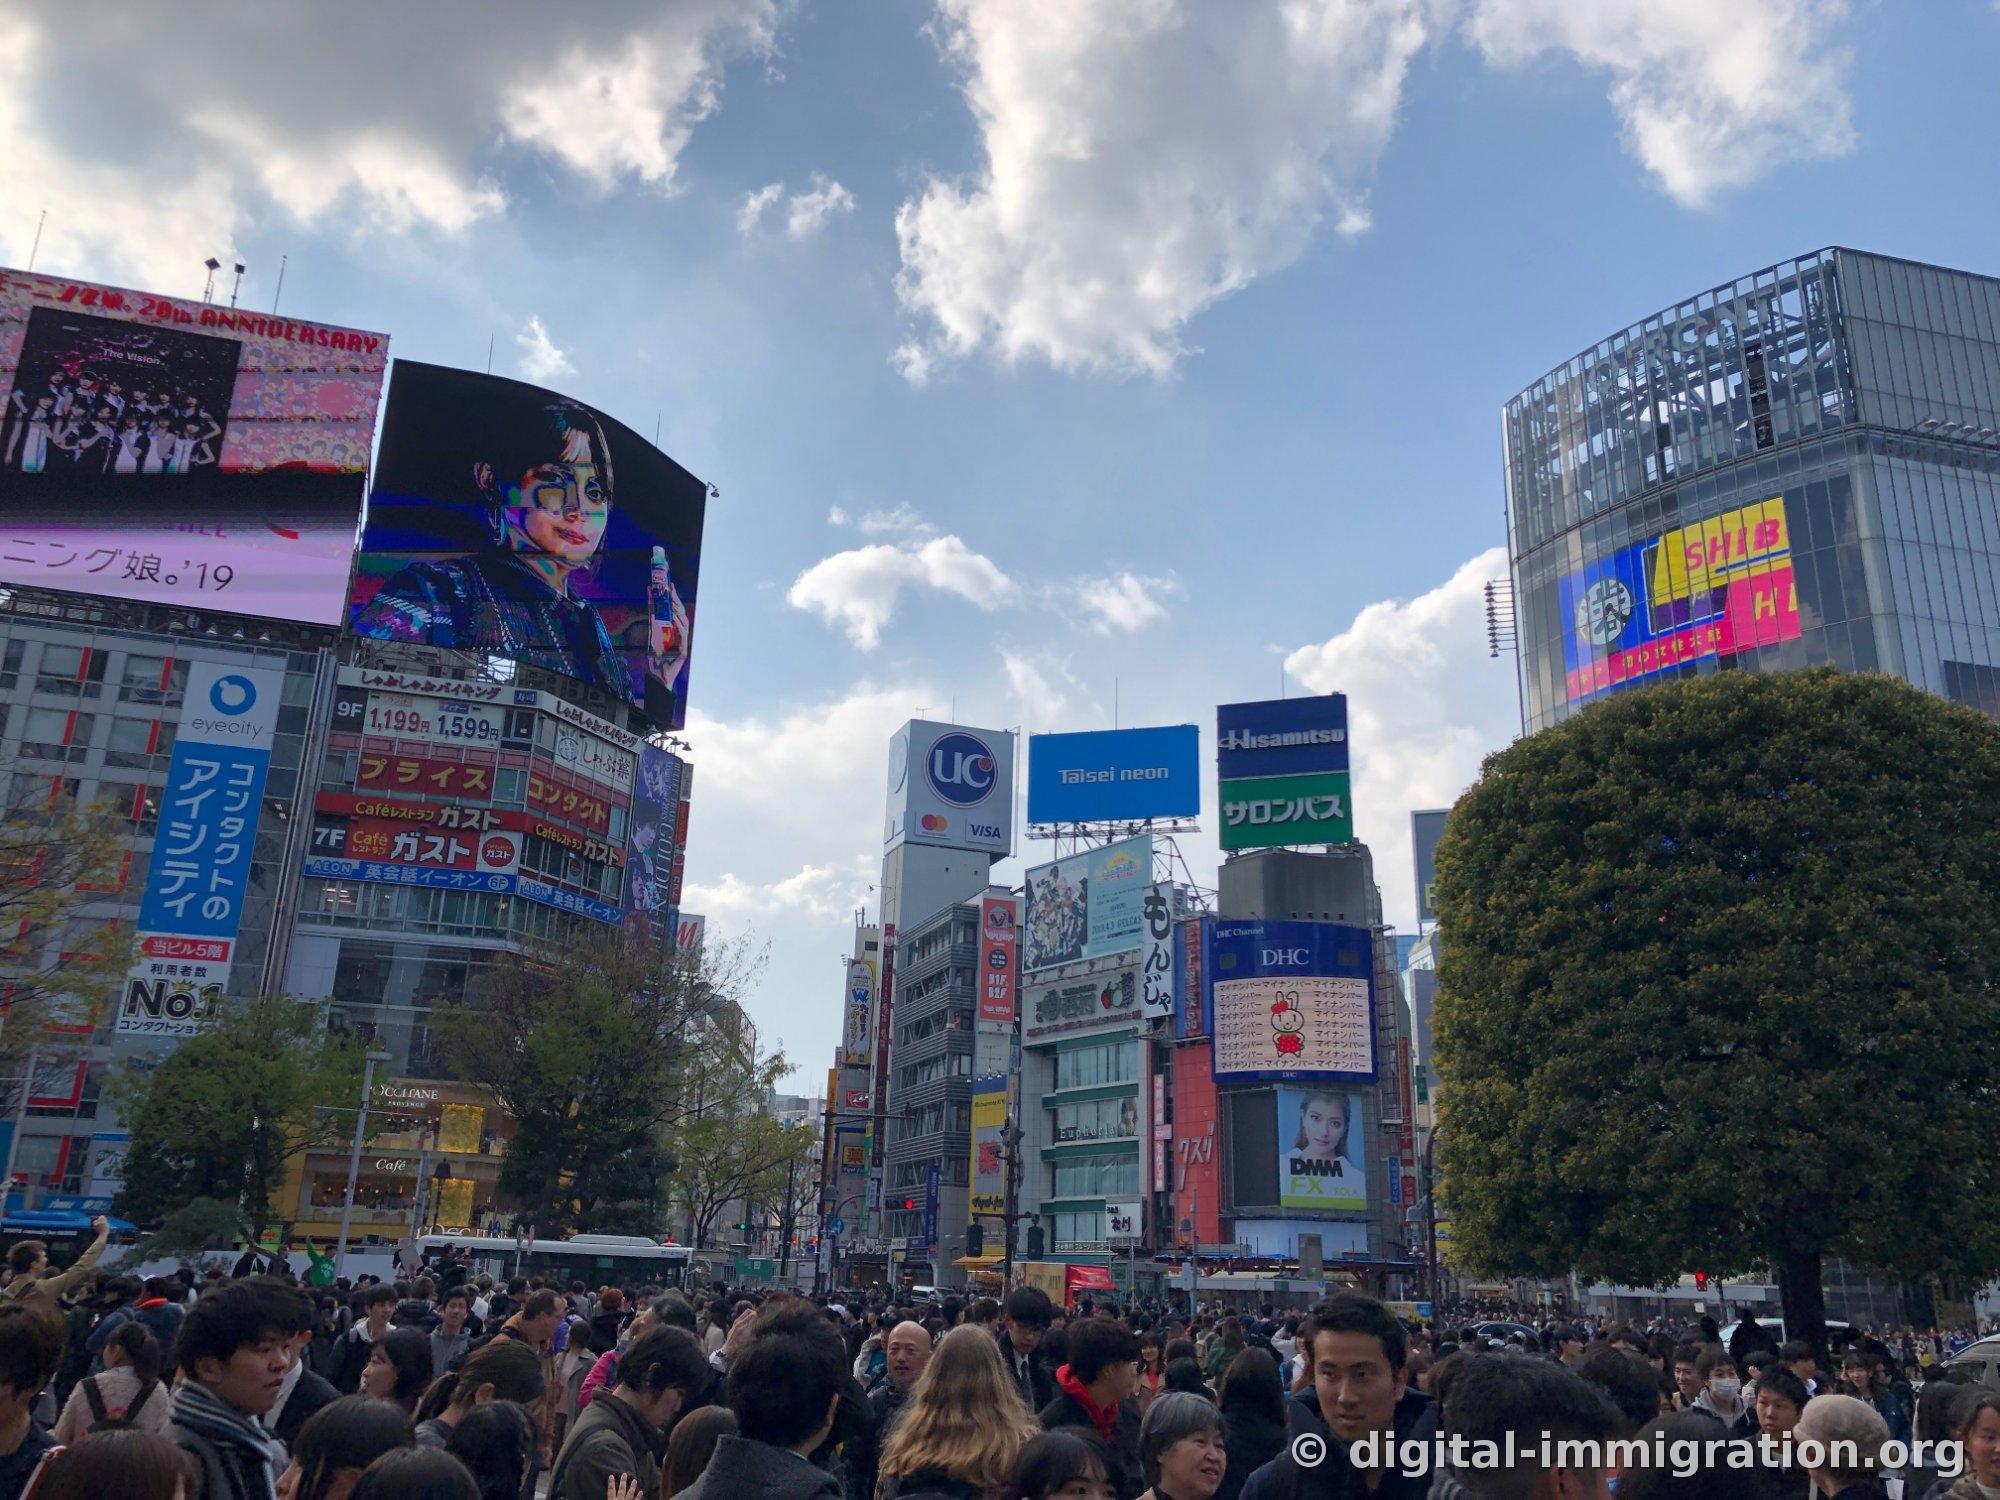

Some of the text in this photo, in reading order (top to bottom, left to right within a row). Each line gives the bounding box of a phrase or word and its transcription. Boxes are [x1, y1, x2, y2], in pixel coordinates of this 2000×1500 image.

[200, 308, 379, 354] ANNIVERSARY
[103, 348, 161, 365] The Vision
[362, 671, 501, 699] しゃぶしゃぶバイキング
[337, 701, 363, 718] 9F
[370, 707, 431, 733] 1,199円
[192, 717, 263, 740] eyecity
[438, 714, 499, 741] 1,599円
[556, 700, 638, 748] しゃぶしゃぶバイキング
[1218, 728, 1345, 750] Hisamitsu
[582, 741, 630, 780] しゃぶ葉
[361, 758, 488, 792] プライス
[1058, 767, 1168, 784] Taisei neon
[528, 778, 606, 824] コンタクト
[1223, 795, 1344, 825] サロンパス
[438, 806, 501, 831] ガスト
[159, 758, 221, 918] アイシティ
[202, 762, 254, 921] コンタクトの
[315, 827, 346, 846] 7F
[352, 830, 388, 847] Café
[971, 824, 1001, 838] VISA
[352, 845, 387, 856] レストラン
[390, 831, 470, 864] ガスト
[486, 849, 512, 860] ガスト
[583, 837, 619, 865] ガスト
[312, 859, 352, 874] AEON
[490, 876, 507, 889] 6F
[523, 881, 549, 897] AEON
[1217, 926, 1264, 938] DHC Channel
[152, 941, 223, 958] 当ビル5階
[1143, 886, 1172, 1013] もんじゃ
[1262, 949, 1309, 966] DHC
[150, 963, 208, 978] 利用者数
[123, 977, 224, 1020] No.1
[376, 1159, 406, 1172] Café
[1178, 1120, 1215, 1192] クスリ
[1290, 1158, 1343, 1178] DMM
[1290, 1177, 1323, 1194] FX
